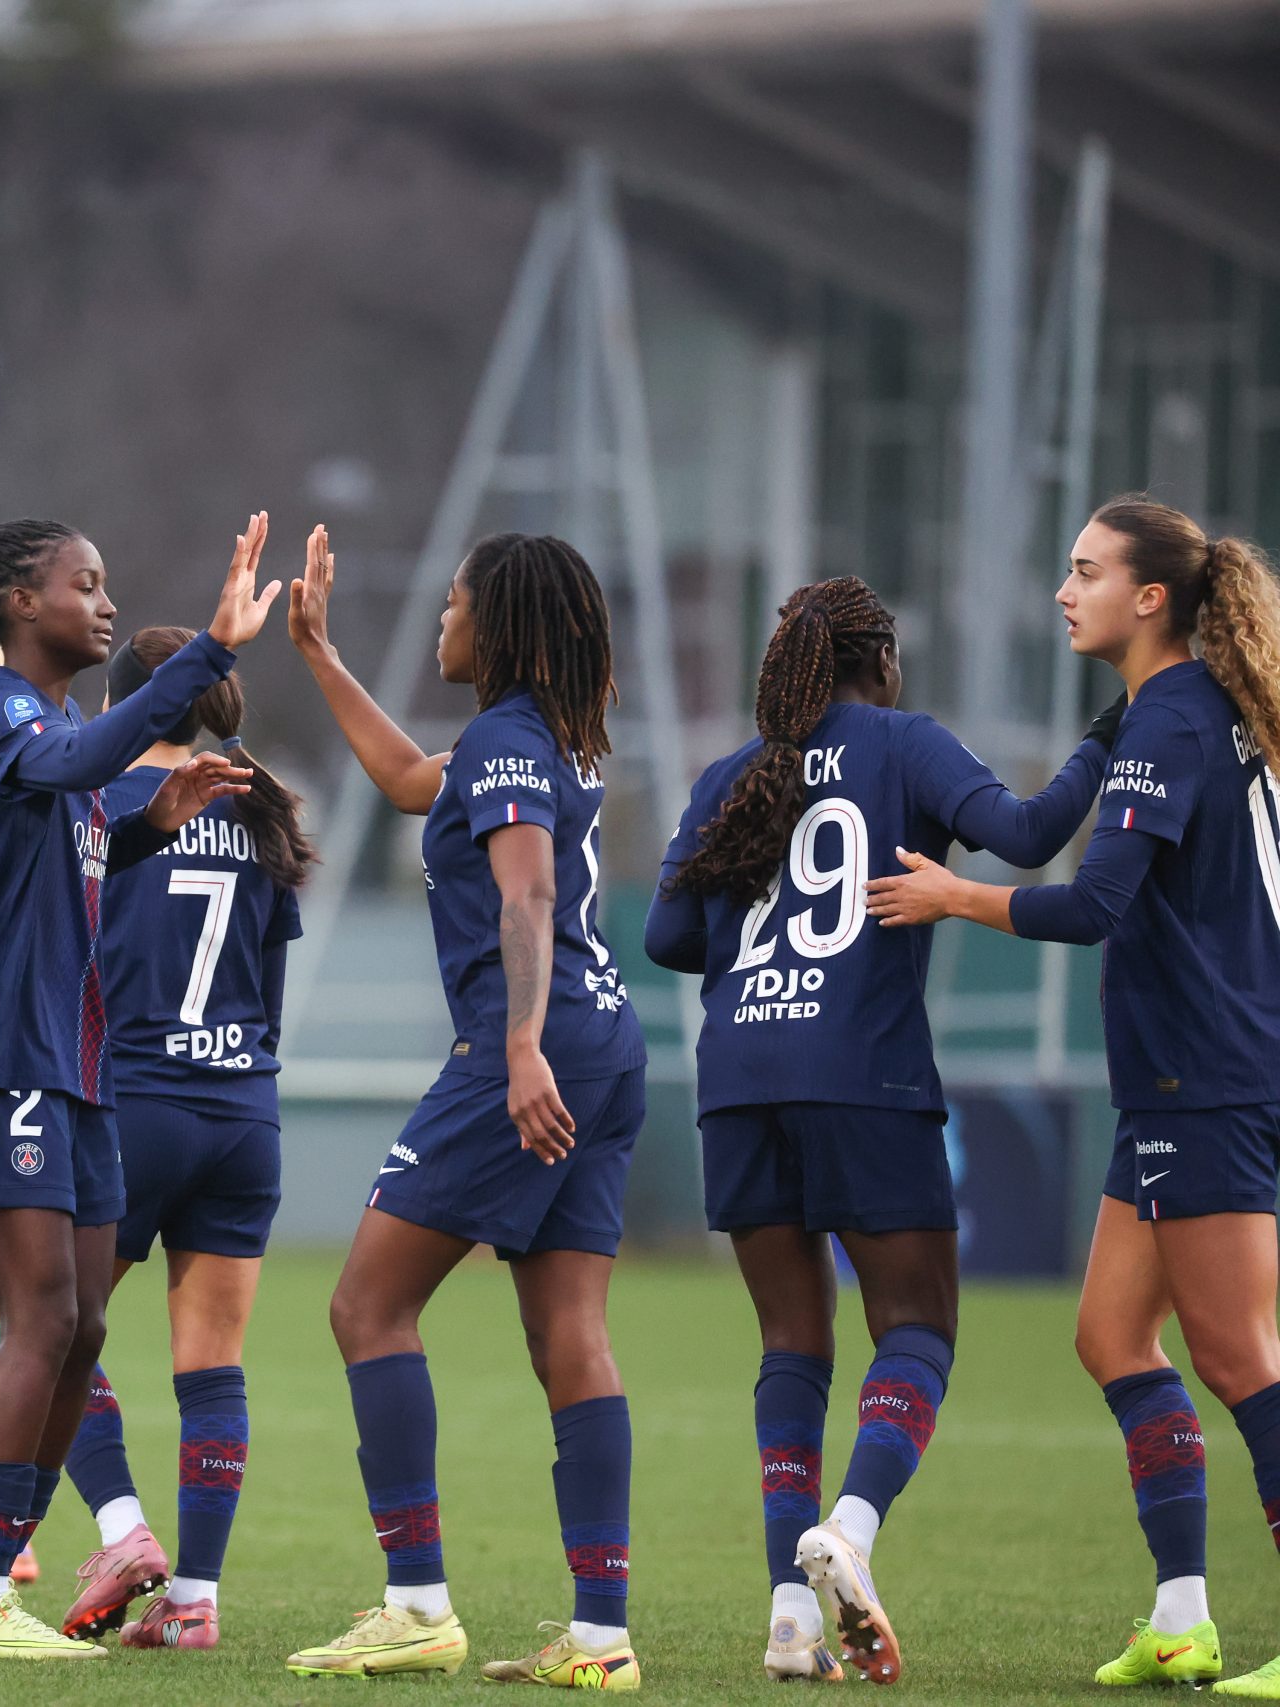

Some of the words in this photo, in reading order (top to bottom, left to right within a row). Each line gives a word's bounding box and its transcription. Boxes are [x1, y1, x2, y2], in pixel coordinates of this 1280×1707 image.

[483, 757, 536, 774] VISIT
[1113, 760, 1155, 777] VISIT
[471, 772, 551, 797] RWANDA
[73, 821, 112, 863] QATA
[727, 797, 870, 974] 29
[167, 869, 239, 1027] 7
[733, 1001, 821, 1025] UNITED
[9, 1089, 44, 1137] 2
[861, 1395, 910, 1412] PARIS
[202, 1458, 246, 1473] PARIS
[763, 1461, 807, 1477] PARIS
